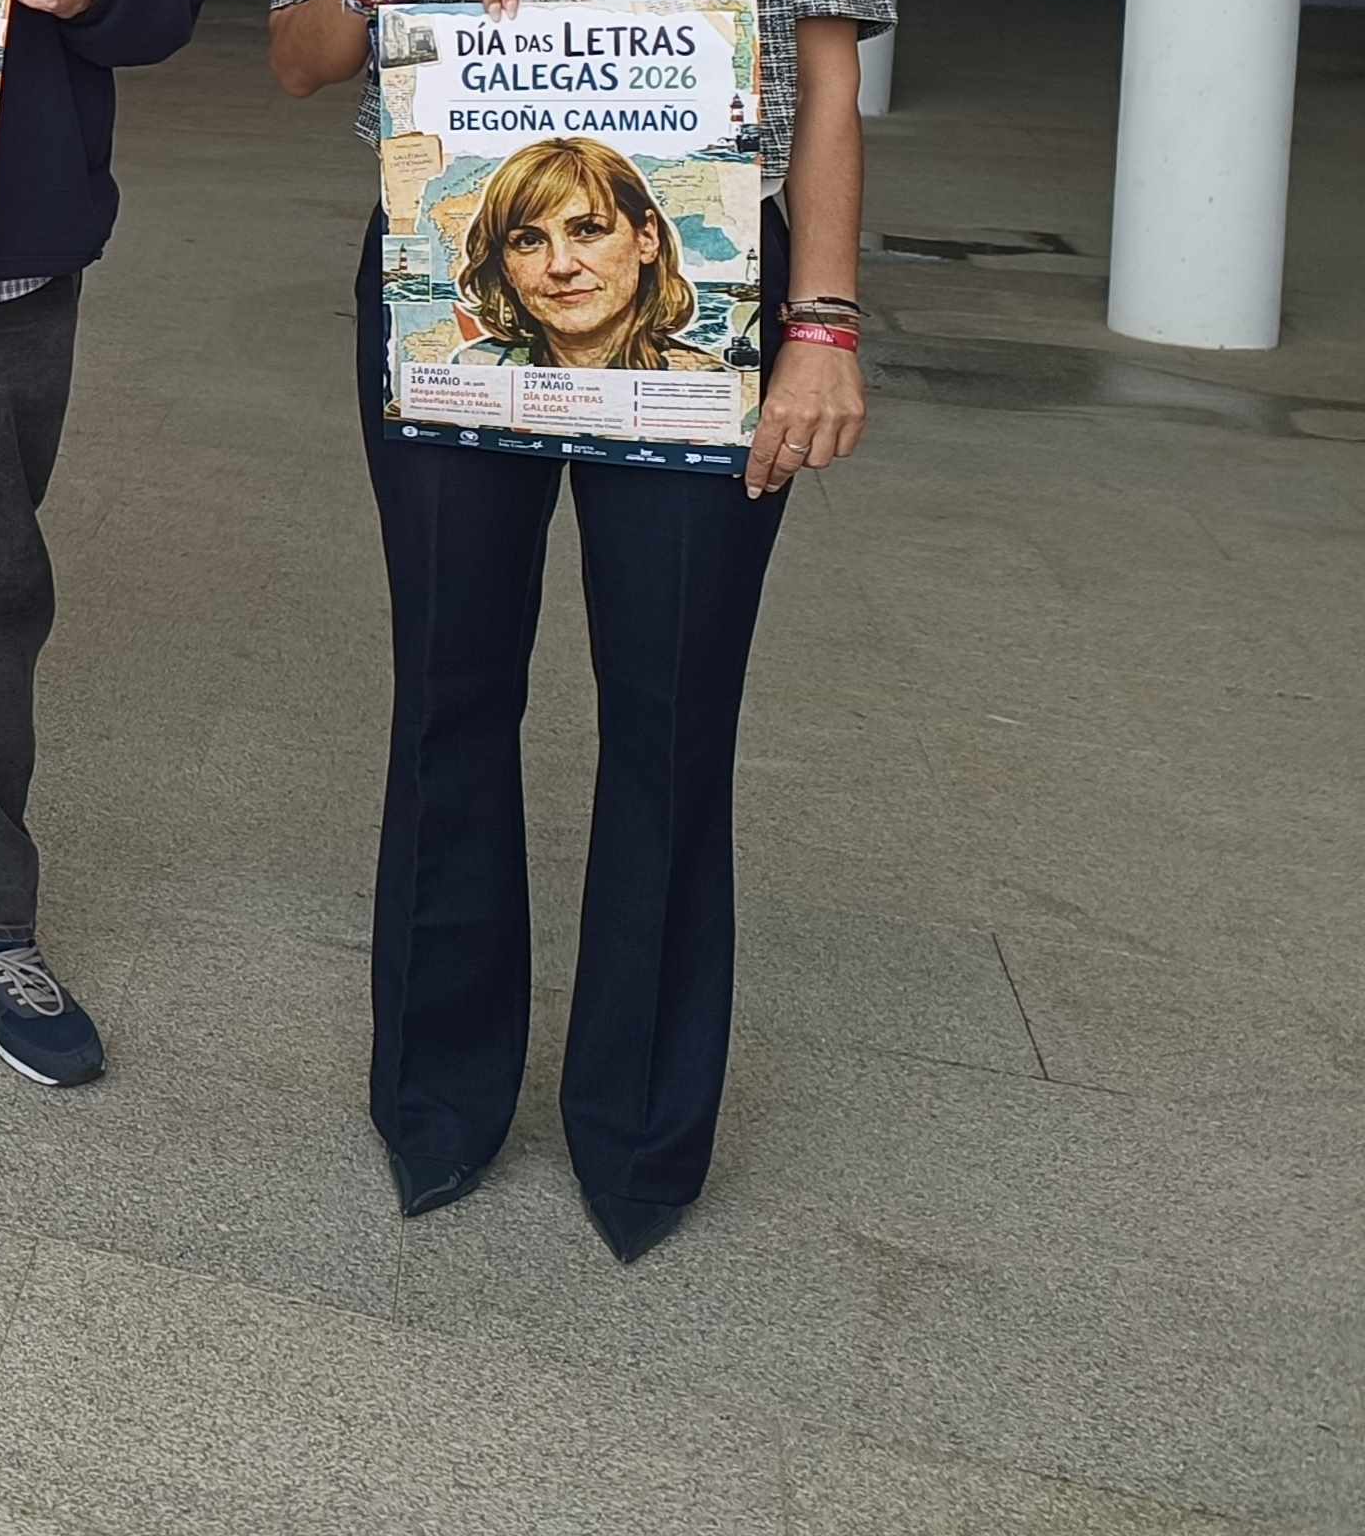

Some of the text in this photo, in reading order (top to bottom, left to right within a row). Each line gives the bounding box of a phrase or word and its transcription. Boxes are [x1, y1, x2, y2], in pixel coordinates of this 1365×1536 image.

[455, 21, 696, 58] DÍA DAS LETRAS
[461, 62, 698, 94] GALEGAS 2026
[448, 103, 699, 132] BEGOÑA CAAMAÑO
[411, 366, 450, 376] SÁBADO
[524, 371, 571, 381] DOMINGO
[410, 375, 425, 385] 16
[428, 375, 461, 386] MAIO
[523, 380, 538, 390] 17
[541, 380, 574, 392] MAIO
[542, 393, 564, 403] DAS
[565, 395, 604, 404] LETRAS
